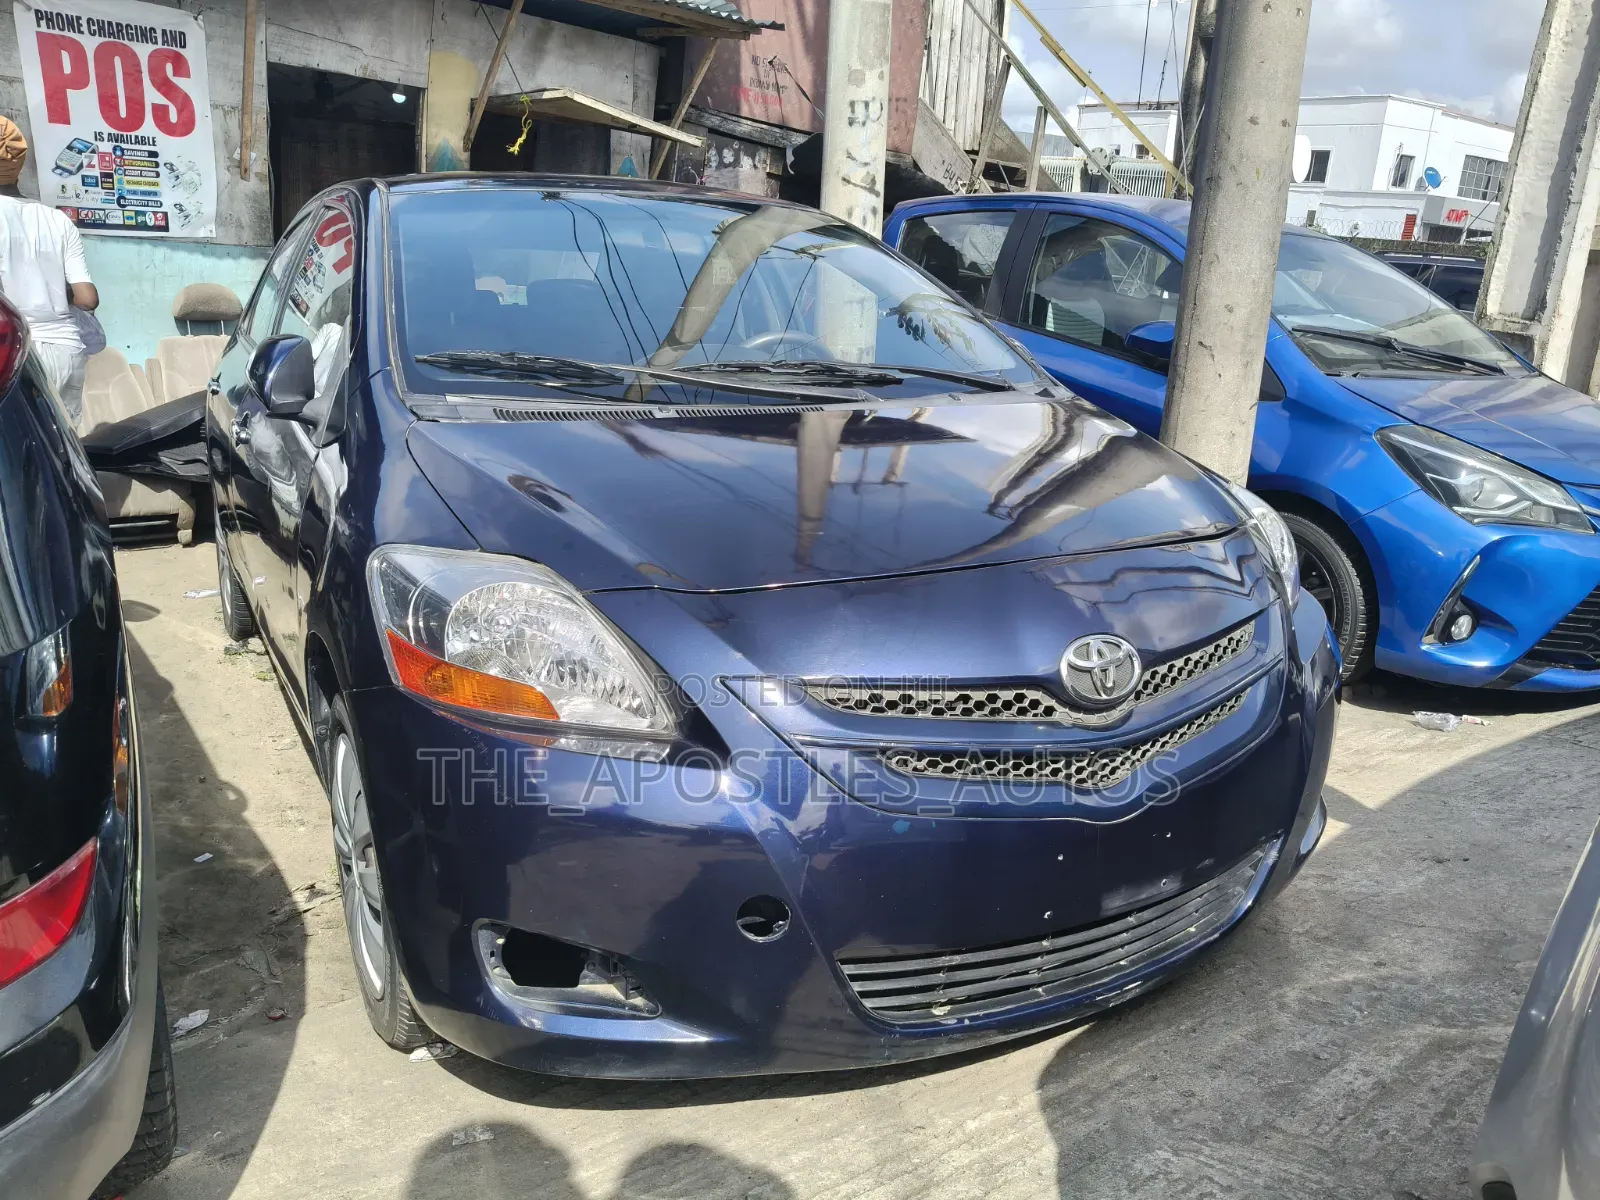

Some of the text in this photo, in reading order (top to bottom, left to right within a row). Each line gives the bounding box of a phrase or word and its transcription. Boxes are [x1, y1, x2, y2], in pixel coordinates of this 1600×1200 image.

[34, 9, 187, 49] PHONE CHARGING AND
[36, 31, 196, 138] POS
[94, 131, 157, 147] IS AVAILABLE
[120, 198, 148, 206] ELECTRICITY
